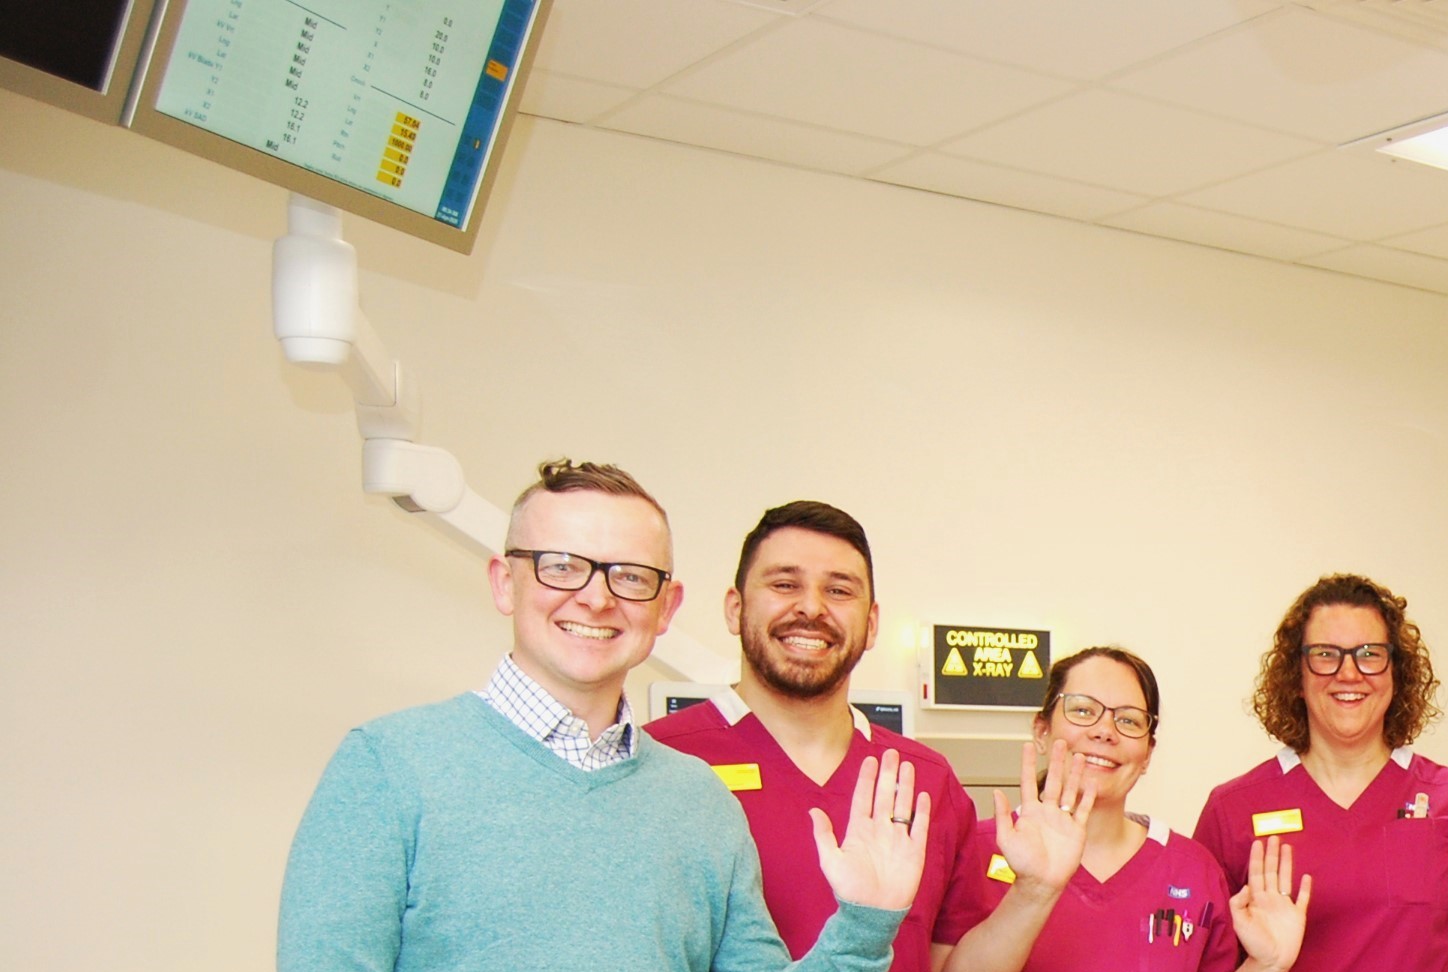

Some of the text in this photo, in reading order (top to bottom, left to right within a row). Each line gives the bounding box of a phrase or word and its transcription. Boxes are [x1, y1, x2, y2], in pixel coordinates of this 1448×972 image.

[946, 630, 1038, 649] CONTROLLED
[973, 647, 1012, 662] AREA
[972, 662, 1013, 677] X-RAY
[1170, 887, 1189, 899] NHS
